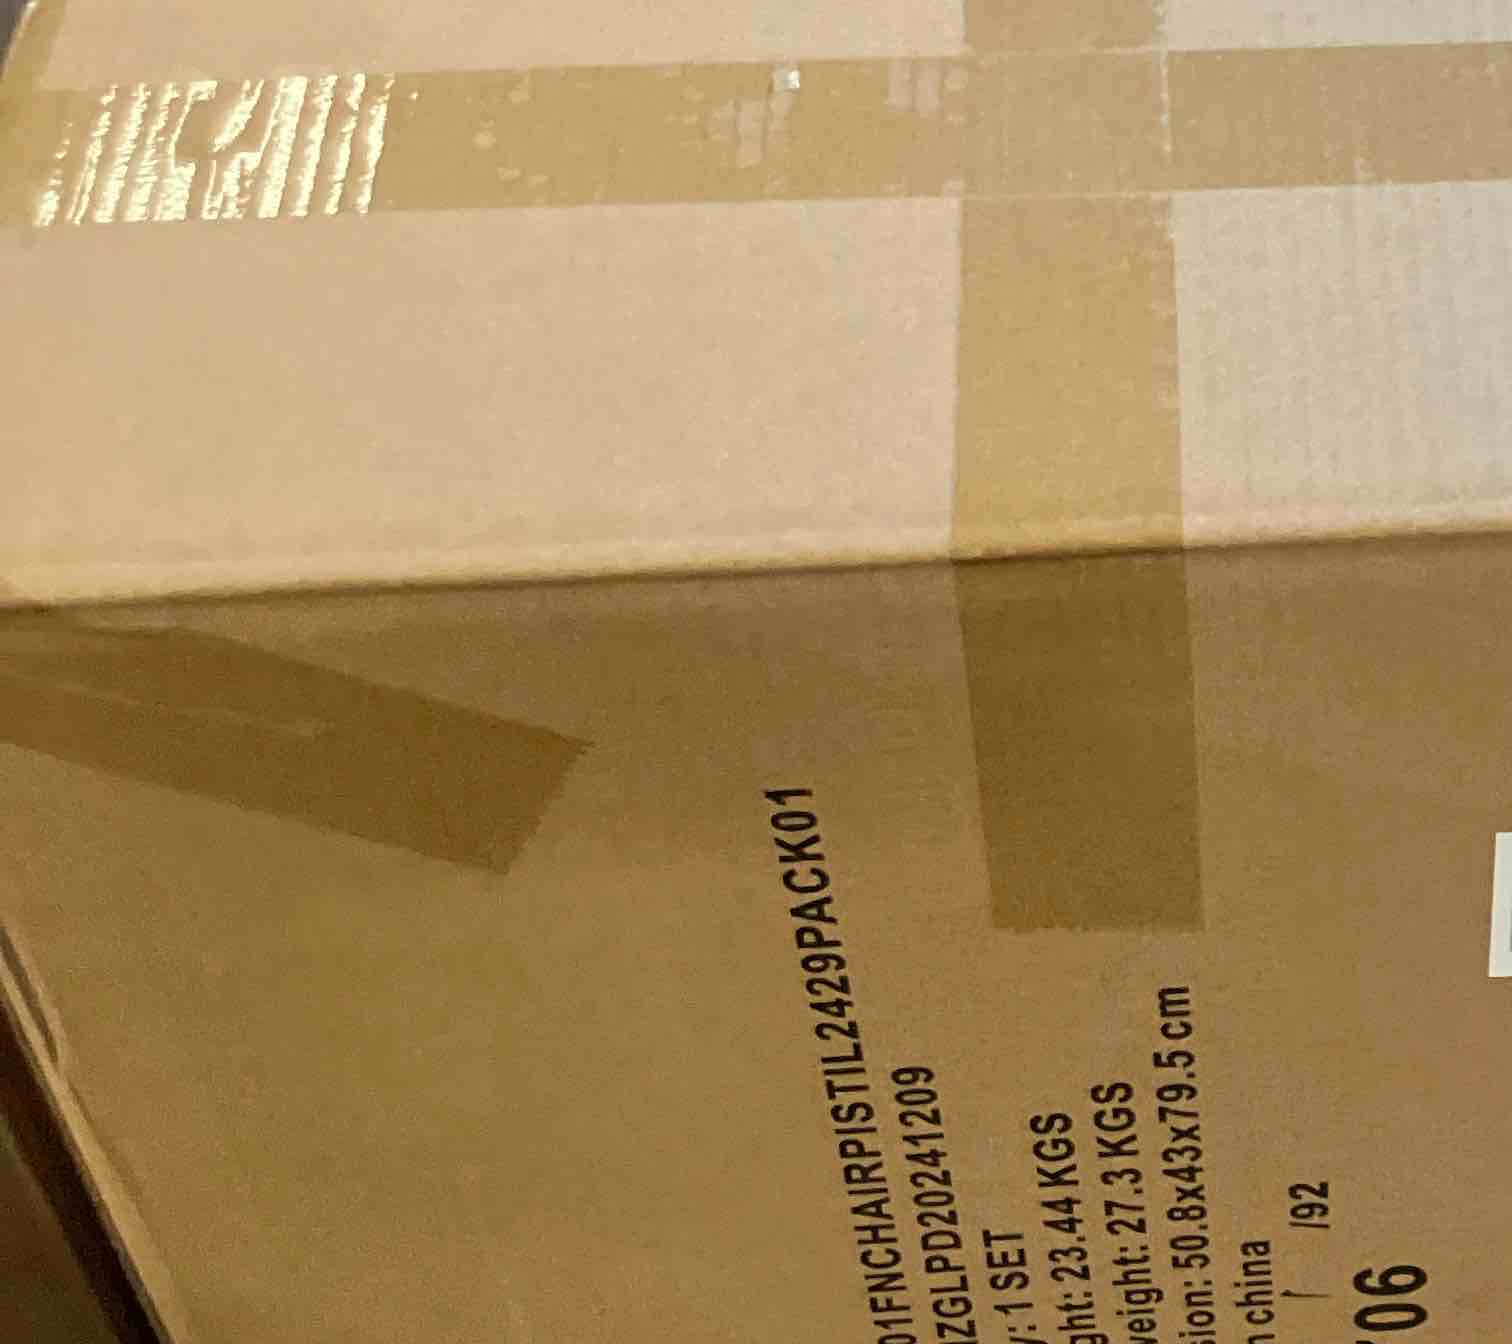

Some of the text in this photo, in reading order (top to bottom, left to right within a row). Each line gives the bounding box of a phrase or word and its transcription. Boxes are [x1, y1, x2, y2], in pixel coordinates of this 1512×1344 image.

[1158, 986, 1192, 1041] cm
[1030, 1113, 1080, 1190] KGS
[1090, 1082, 1140, 1159] KGS
[1153, 1050, 1212, 1270] 50.8x43x79.5
[1101, 1168, 1148, 1236] 27.3
[1288, 1182, 1331, 1229] /92
[983, 1228, 1030, 1290] SET
[1042, 1197, 1090, 1282] 23.44
[994, 1302, 1033, 1316] 1
[1235, 1240, 1275, 1325] china
